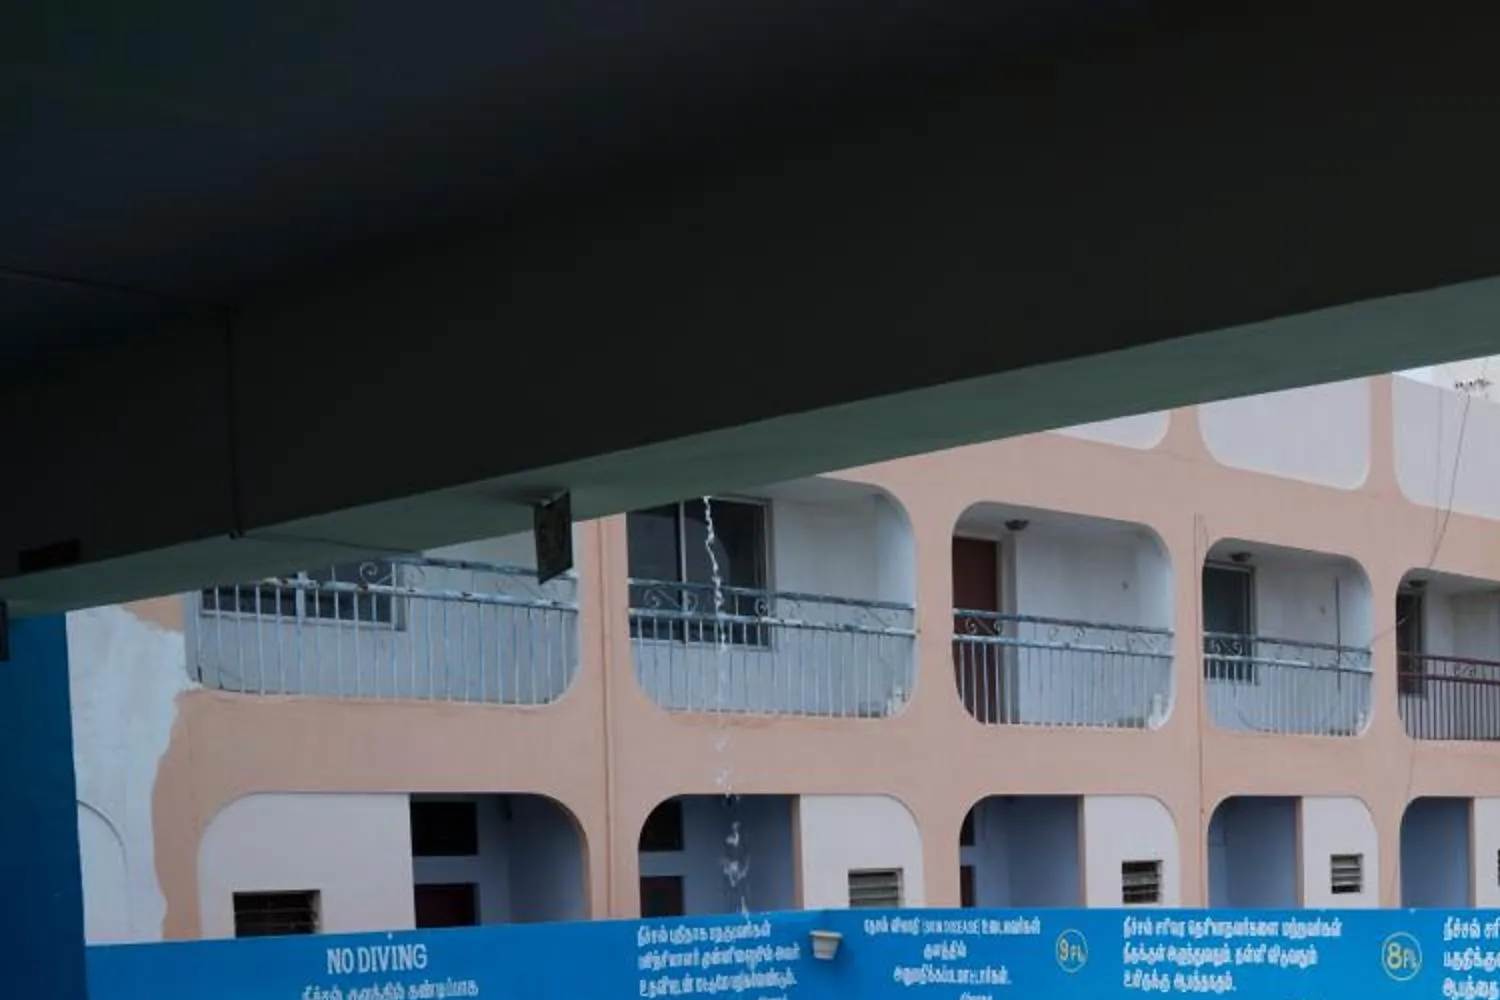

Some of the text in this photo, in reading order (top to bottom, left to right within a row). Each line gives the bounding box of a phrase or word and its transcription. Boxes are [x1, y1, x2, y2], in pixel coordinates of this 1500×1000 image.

[1443, 916, 1481, 942] நீச்சல்
[327, 943, 428, 975] NO DIVING
